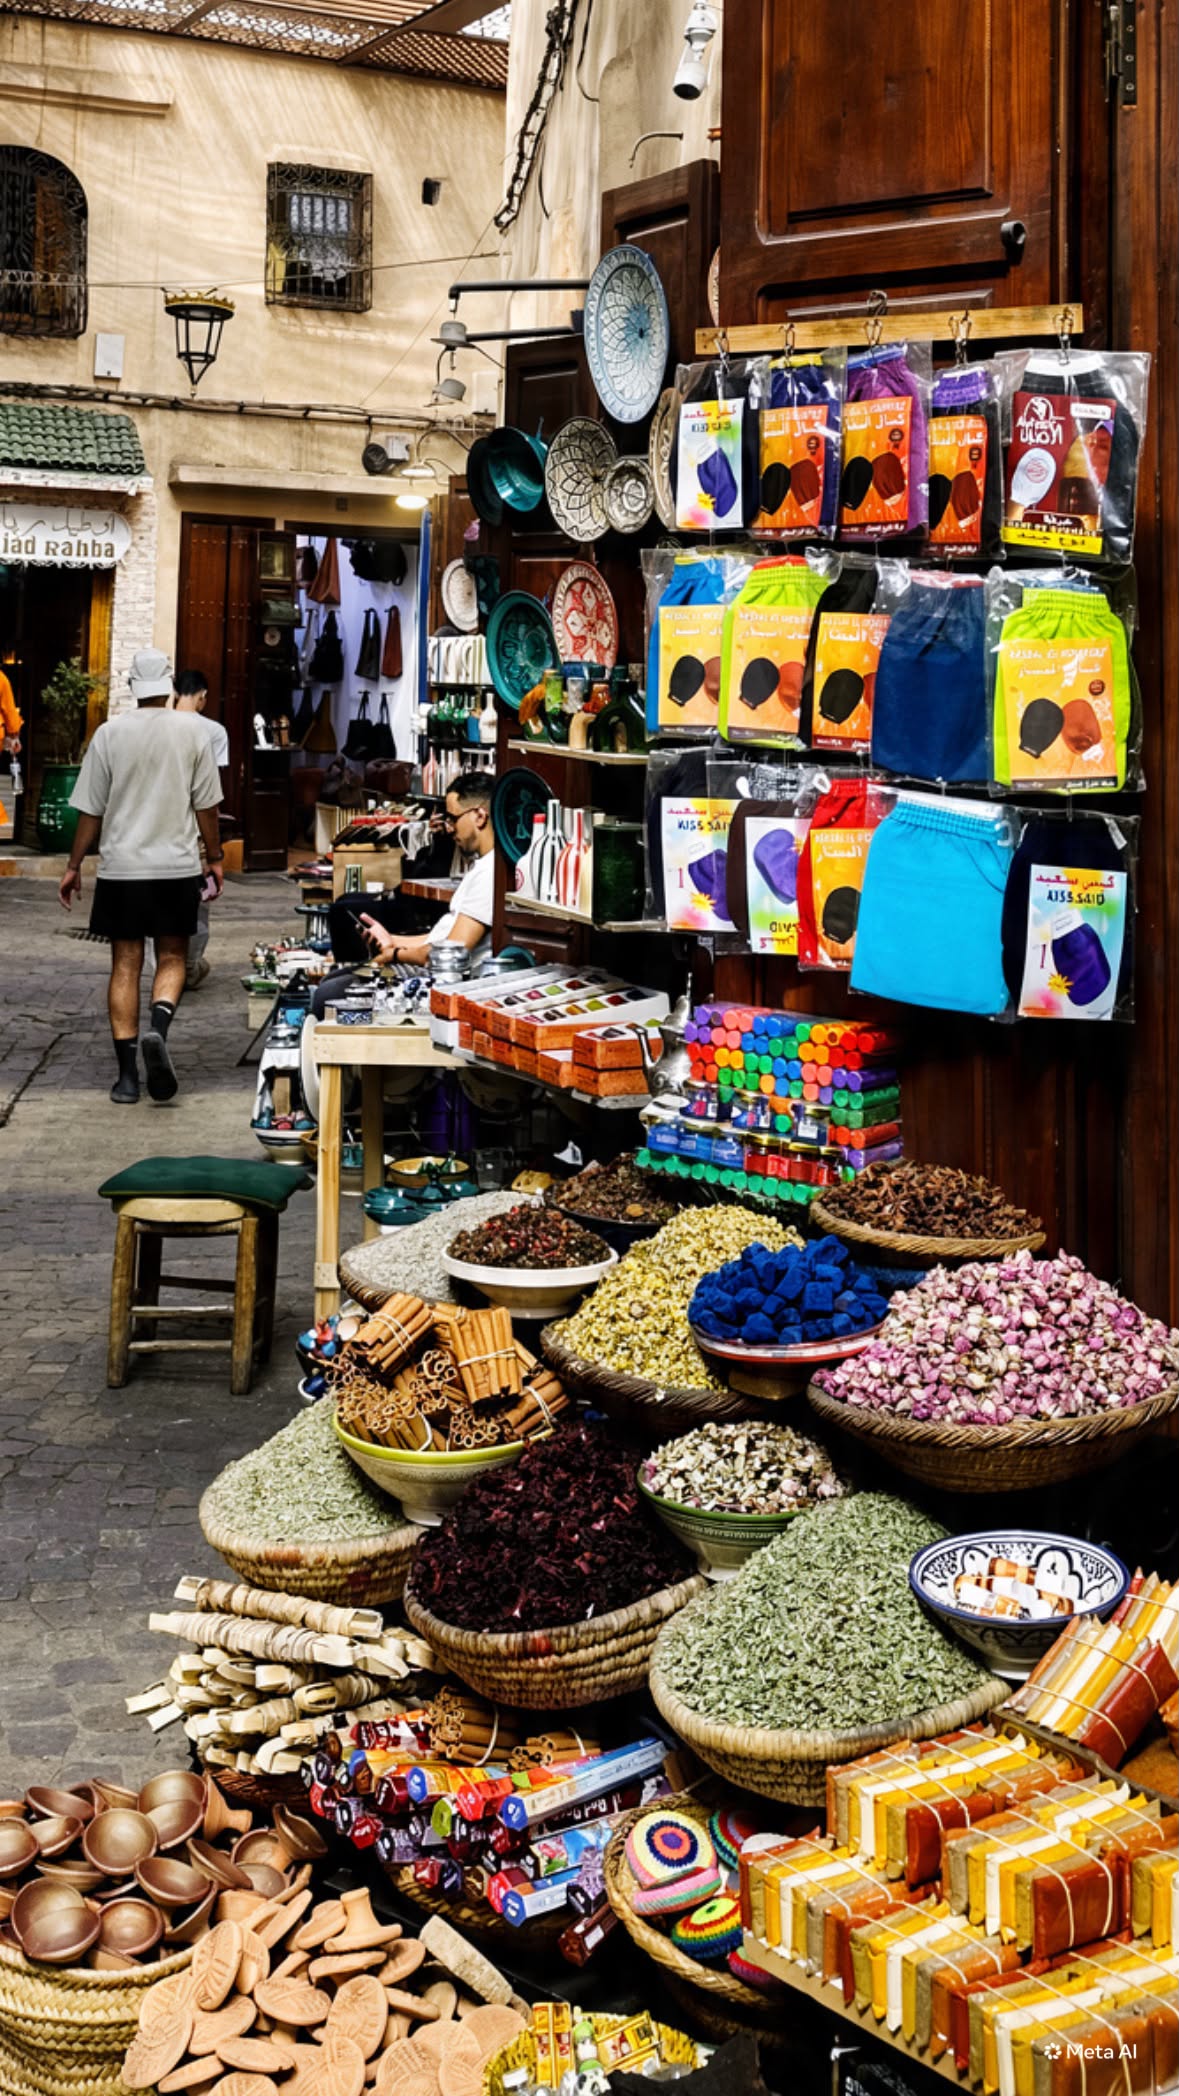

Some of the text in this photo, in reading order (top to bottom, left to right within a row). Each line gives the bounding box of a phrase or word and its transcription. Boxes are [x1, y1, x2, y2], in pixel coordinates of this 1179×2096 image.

[2, 532, 115, 558] iad Rahba
[707, 820, 727, 832] SAI
[769, 921, 798, 933] AID
